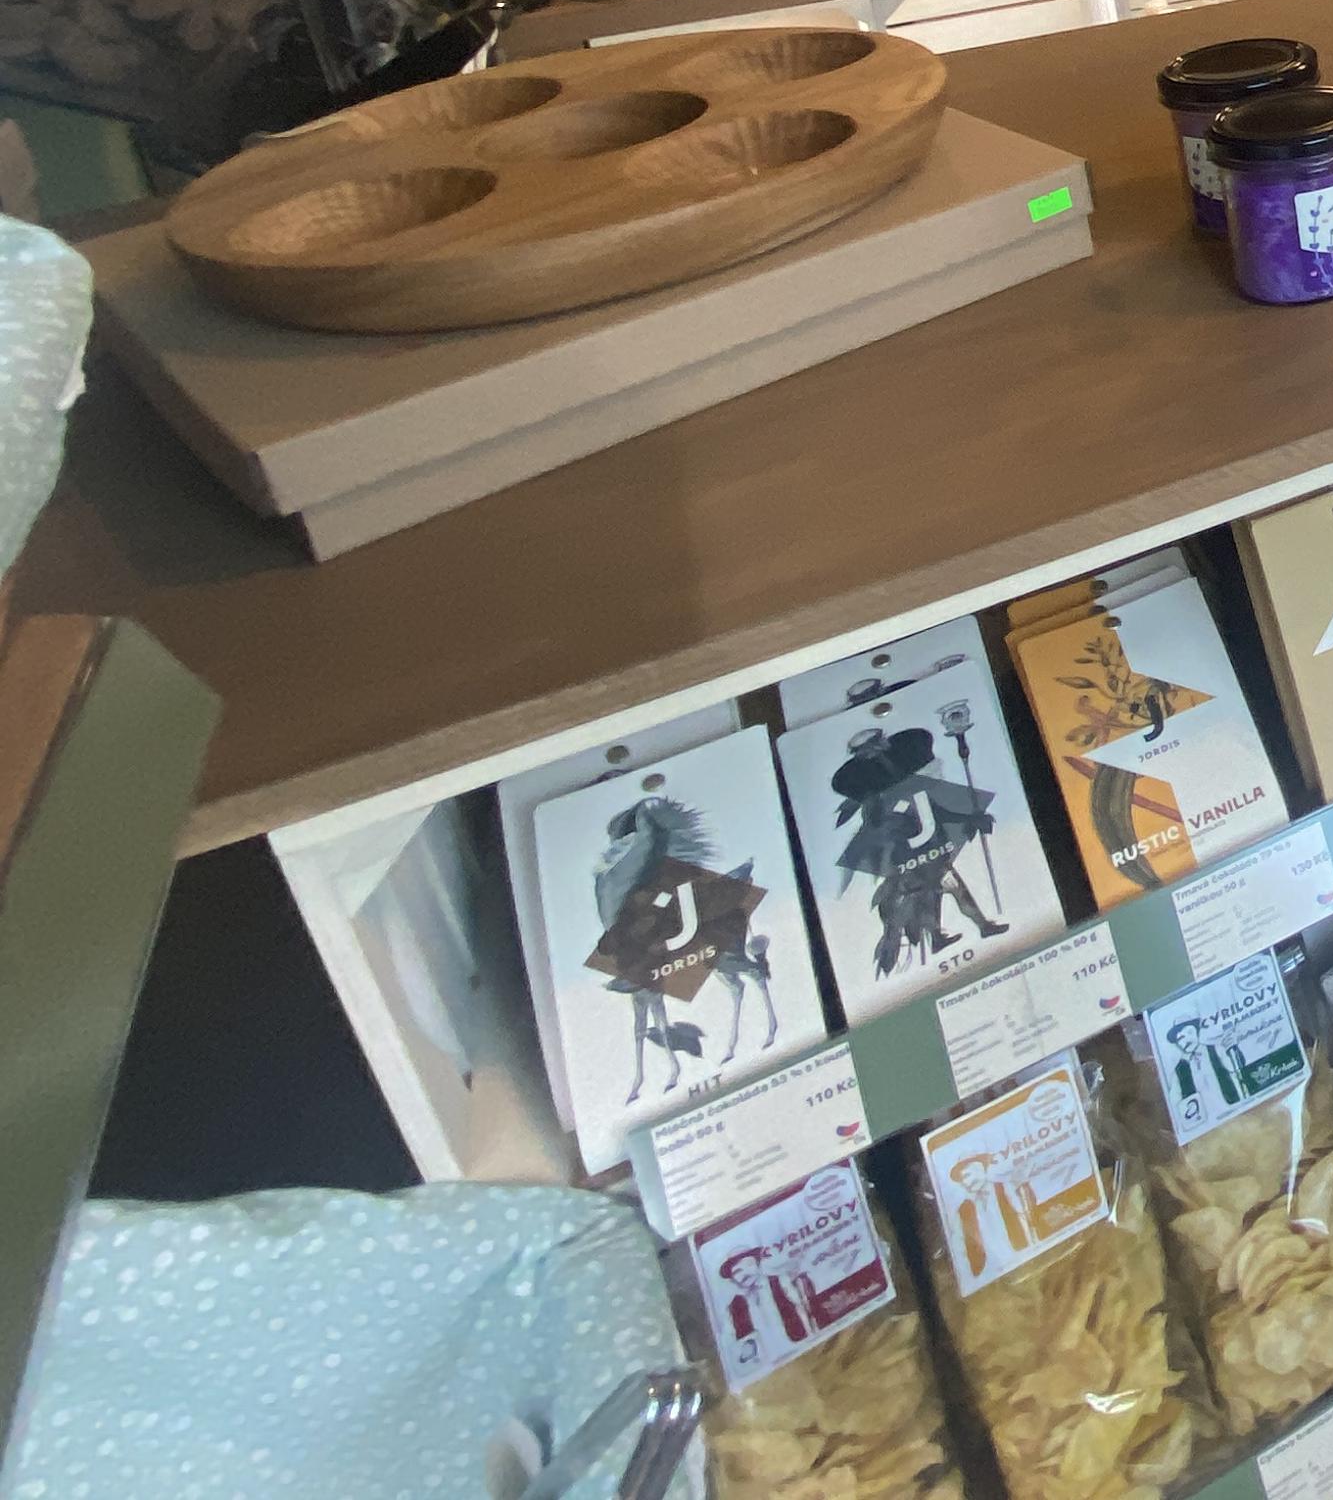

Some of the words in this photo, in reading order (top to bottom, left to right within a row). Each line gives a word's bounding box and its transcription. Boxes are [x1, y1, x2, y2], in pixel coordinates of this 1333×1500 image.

[1138, 739, 1181, 763] JORDIS
[1187, 785, 1266, 830] VANILLA
[898, 840, 955, 875] JORDIS
[1111, 825, 1181, 868] RUSTIC
[654, 881, 698, 951] J
[651, 945, 717, 981] JORDIS
[938, 949, 975, 974] STO
[1072, 963, 1097, 981] 110
[1099, 953, 1117, 970] Kč
[939, 985, 979, 1010] Tmavá
[1200, 982, 1277, 1030] CYRILOVY
[688, 1073, 723, 1099] HIT
[806, 1088, 834, 1108] 110
[836, 1076, 859, 1095] Kč
[760, 1198, 858, 1259] CYRILOVY
